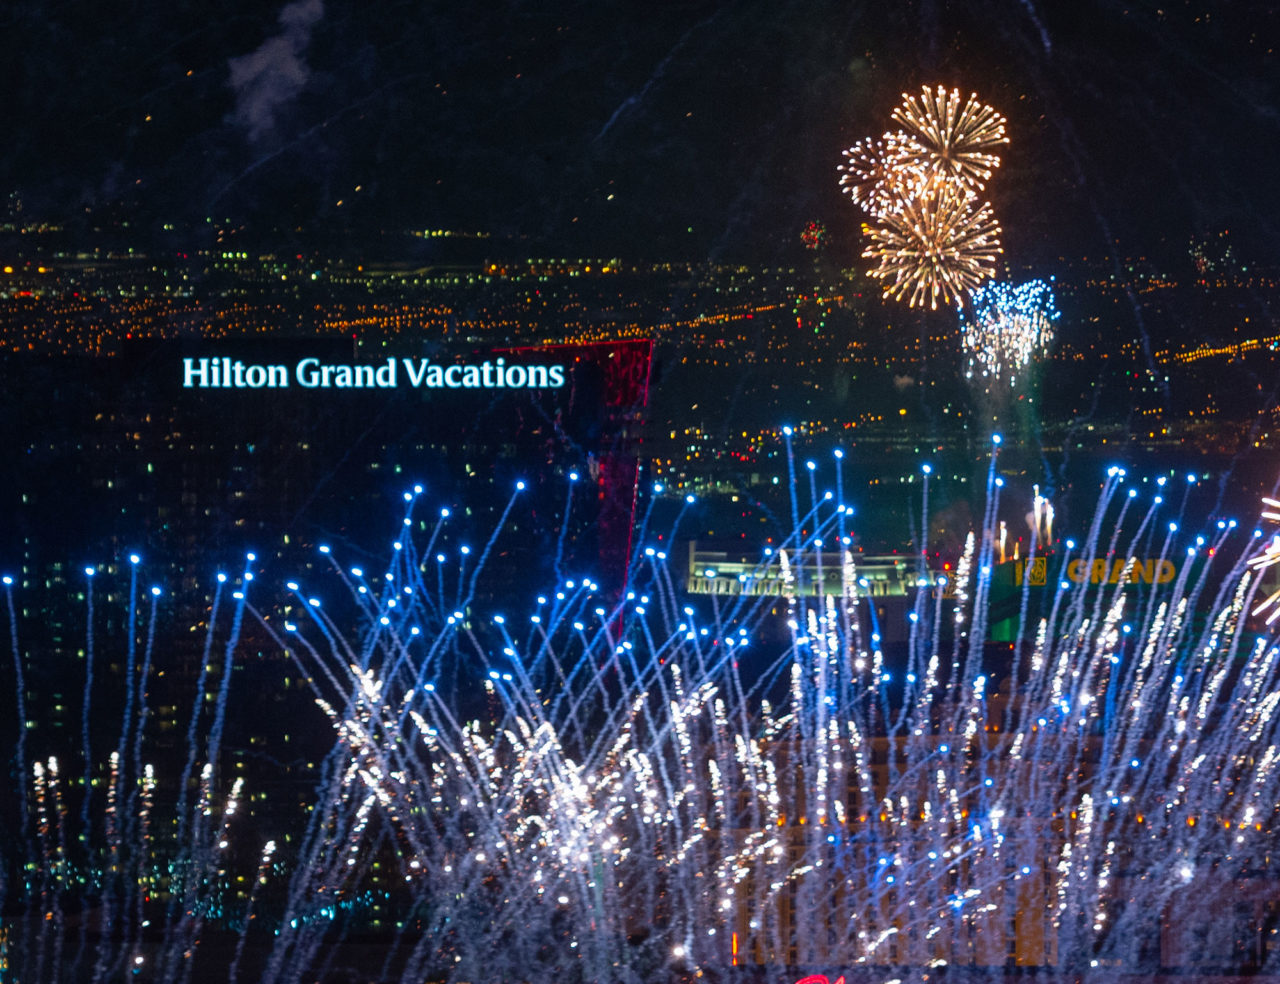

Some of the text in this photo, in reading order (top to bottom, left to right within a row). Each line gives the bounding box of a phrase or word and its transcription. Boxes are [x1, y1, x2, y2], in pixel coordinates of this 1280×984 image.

[183, 357, 565, 388] Hilton Grand Vacations
[1067, 558, 1176, 584] GRAND
